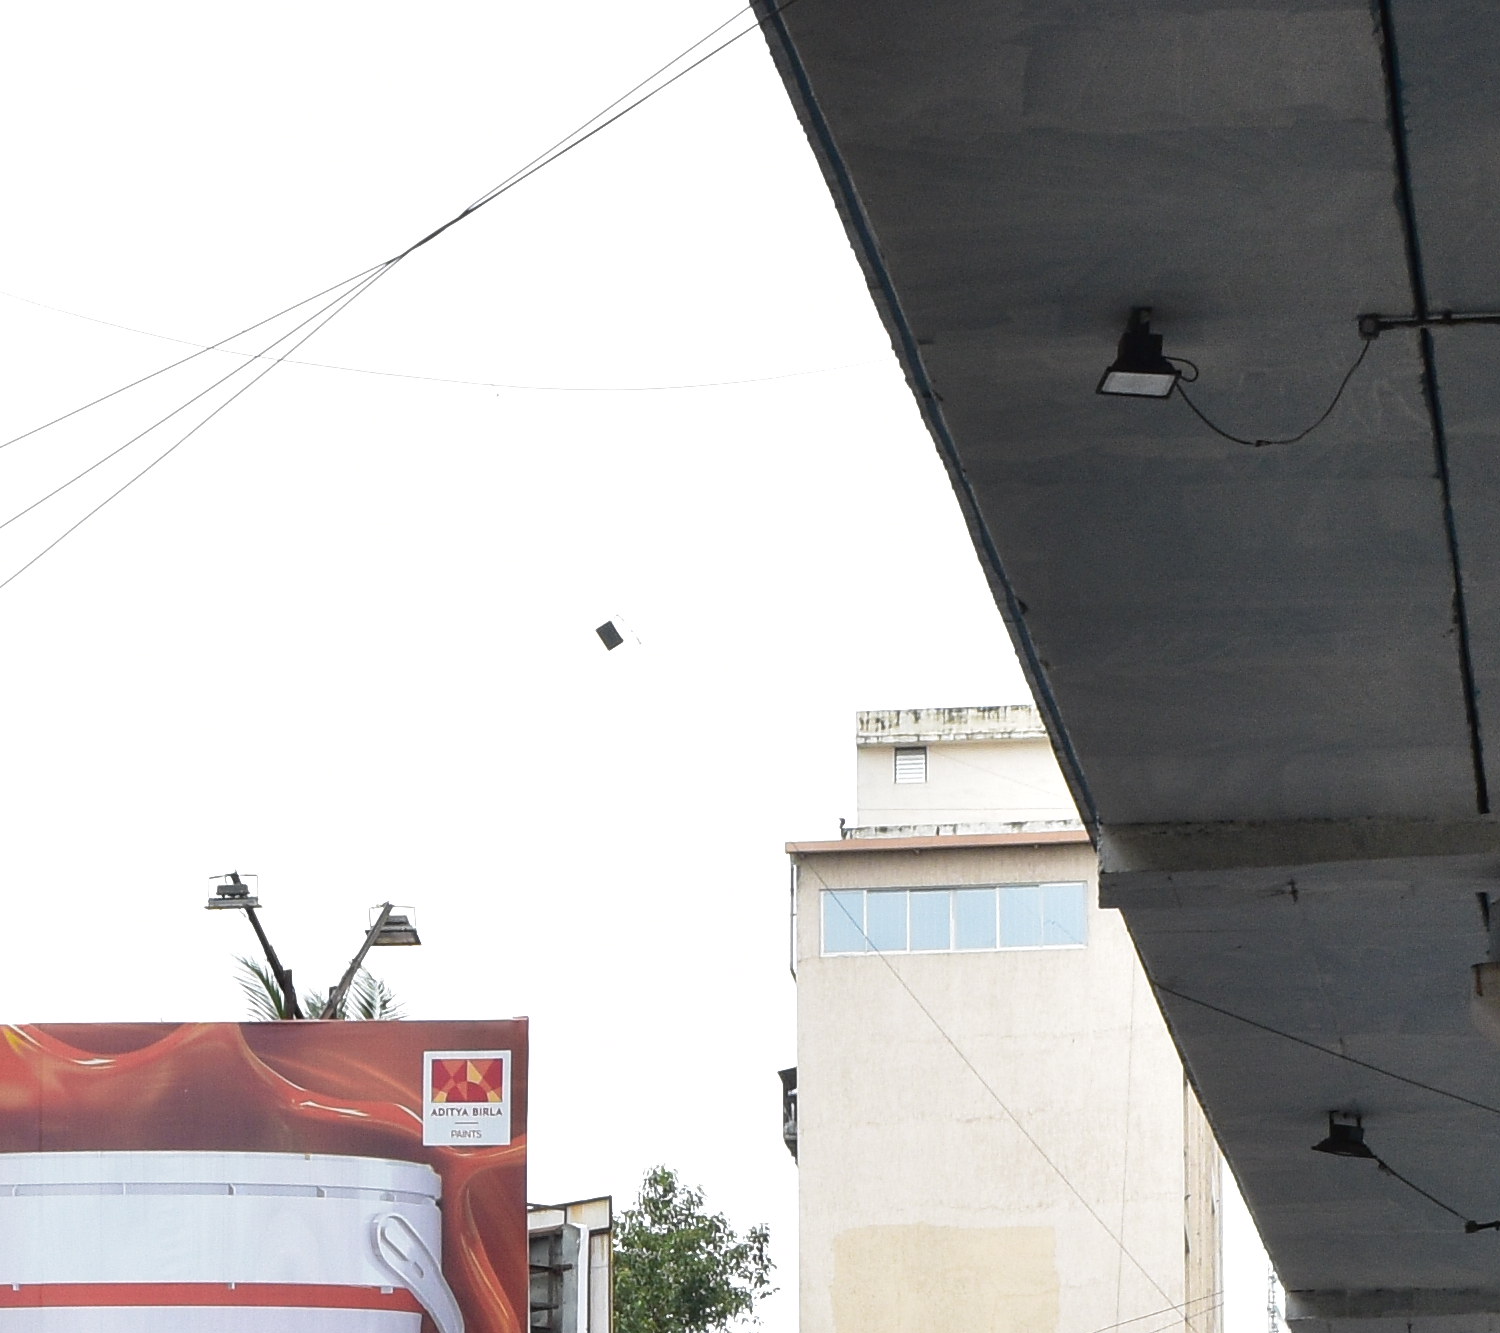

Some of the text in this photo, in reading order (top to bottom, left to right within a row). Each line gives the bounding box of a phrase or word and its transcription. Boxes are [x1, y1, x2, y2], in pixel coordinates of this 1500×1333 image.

[431, 1107, 503, 1116] ADITYA BIRLA
[451, 1129, 482, 1138] PAINTS
